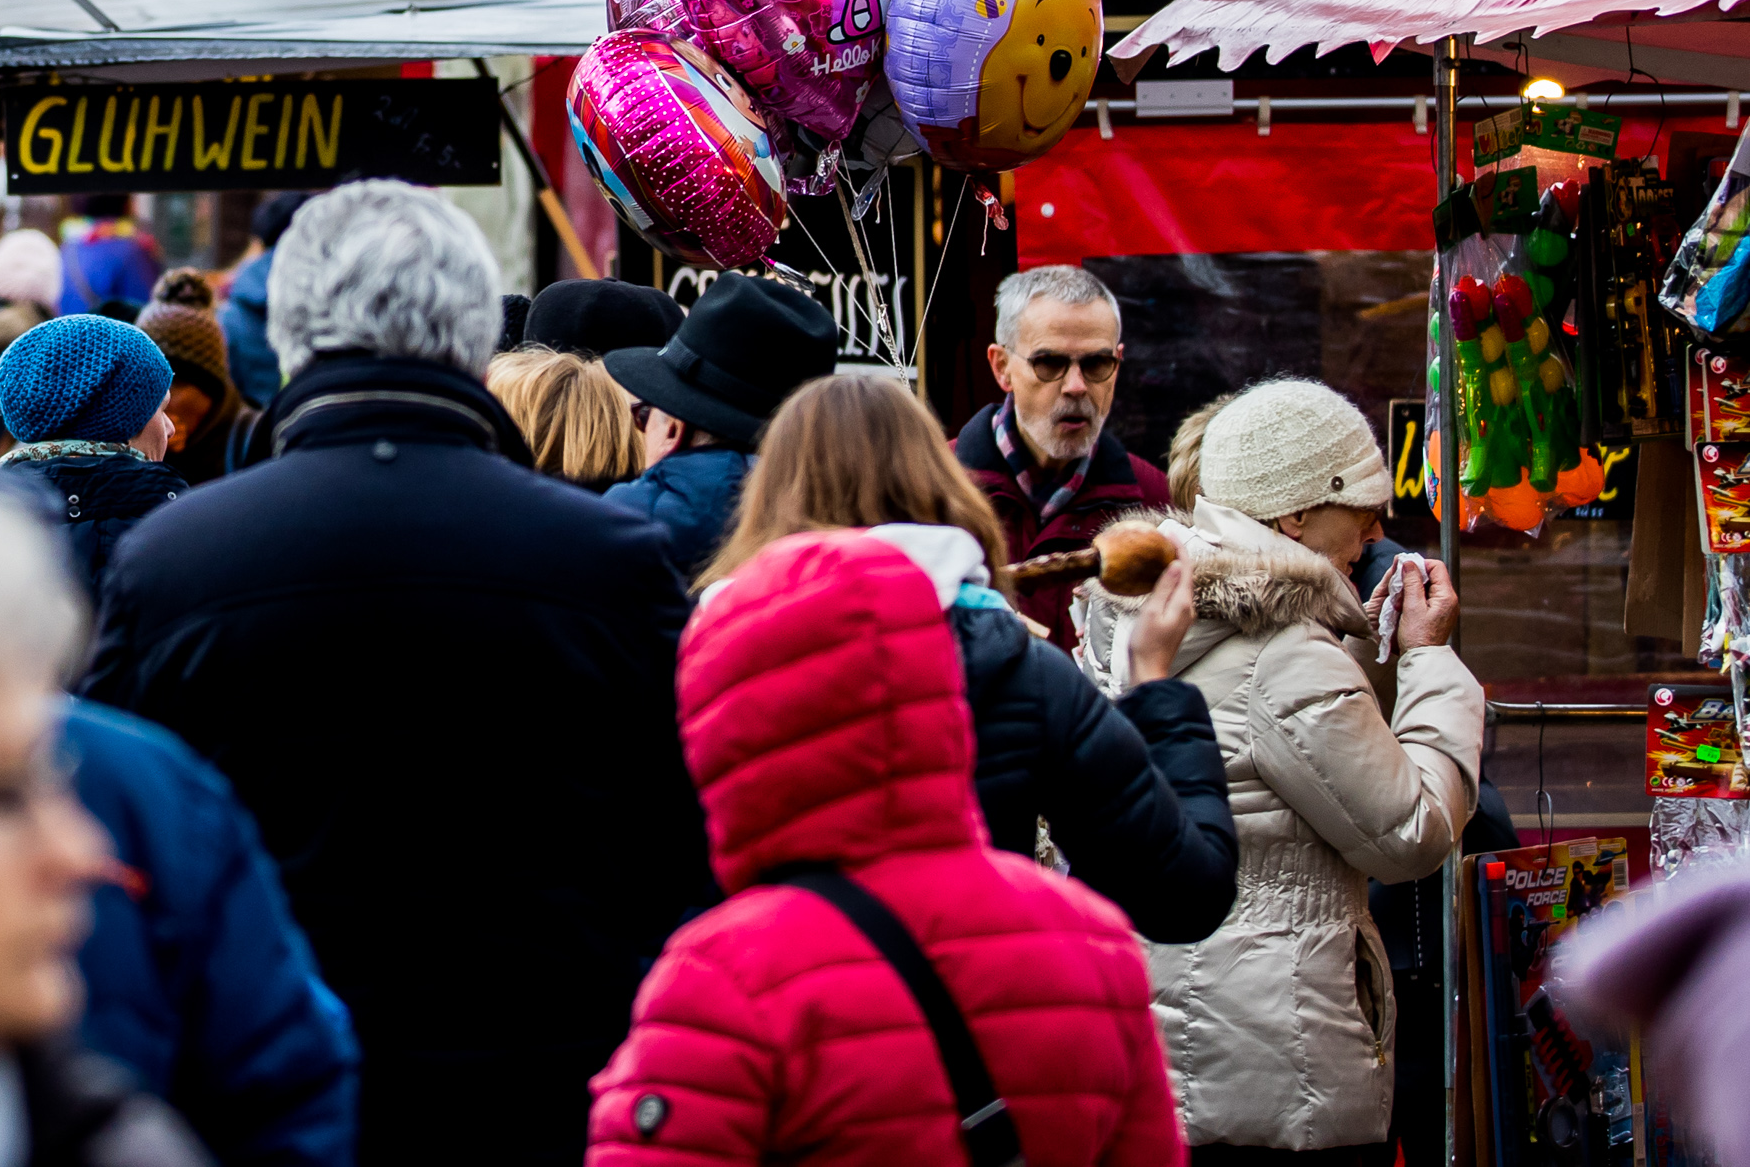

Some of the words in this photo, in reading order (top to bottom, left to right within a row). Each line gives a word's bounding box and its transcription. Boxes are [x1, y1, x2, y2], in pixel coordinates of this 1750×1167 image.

[809, 44, 871, 77] Hello
[17, 85, 344, 176] GLÜHWEIN
[1691, 699, 1735, 721] BA
[1505, 866, 1568, 891] POLICE
[1526, 889, 1568, 907] FORCE
